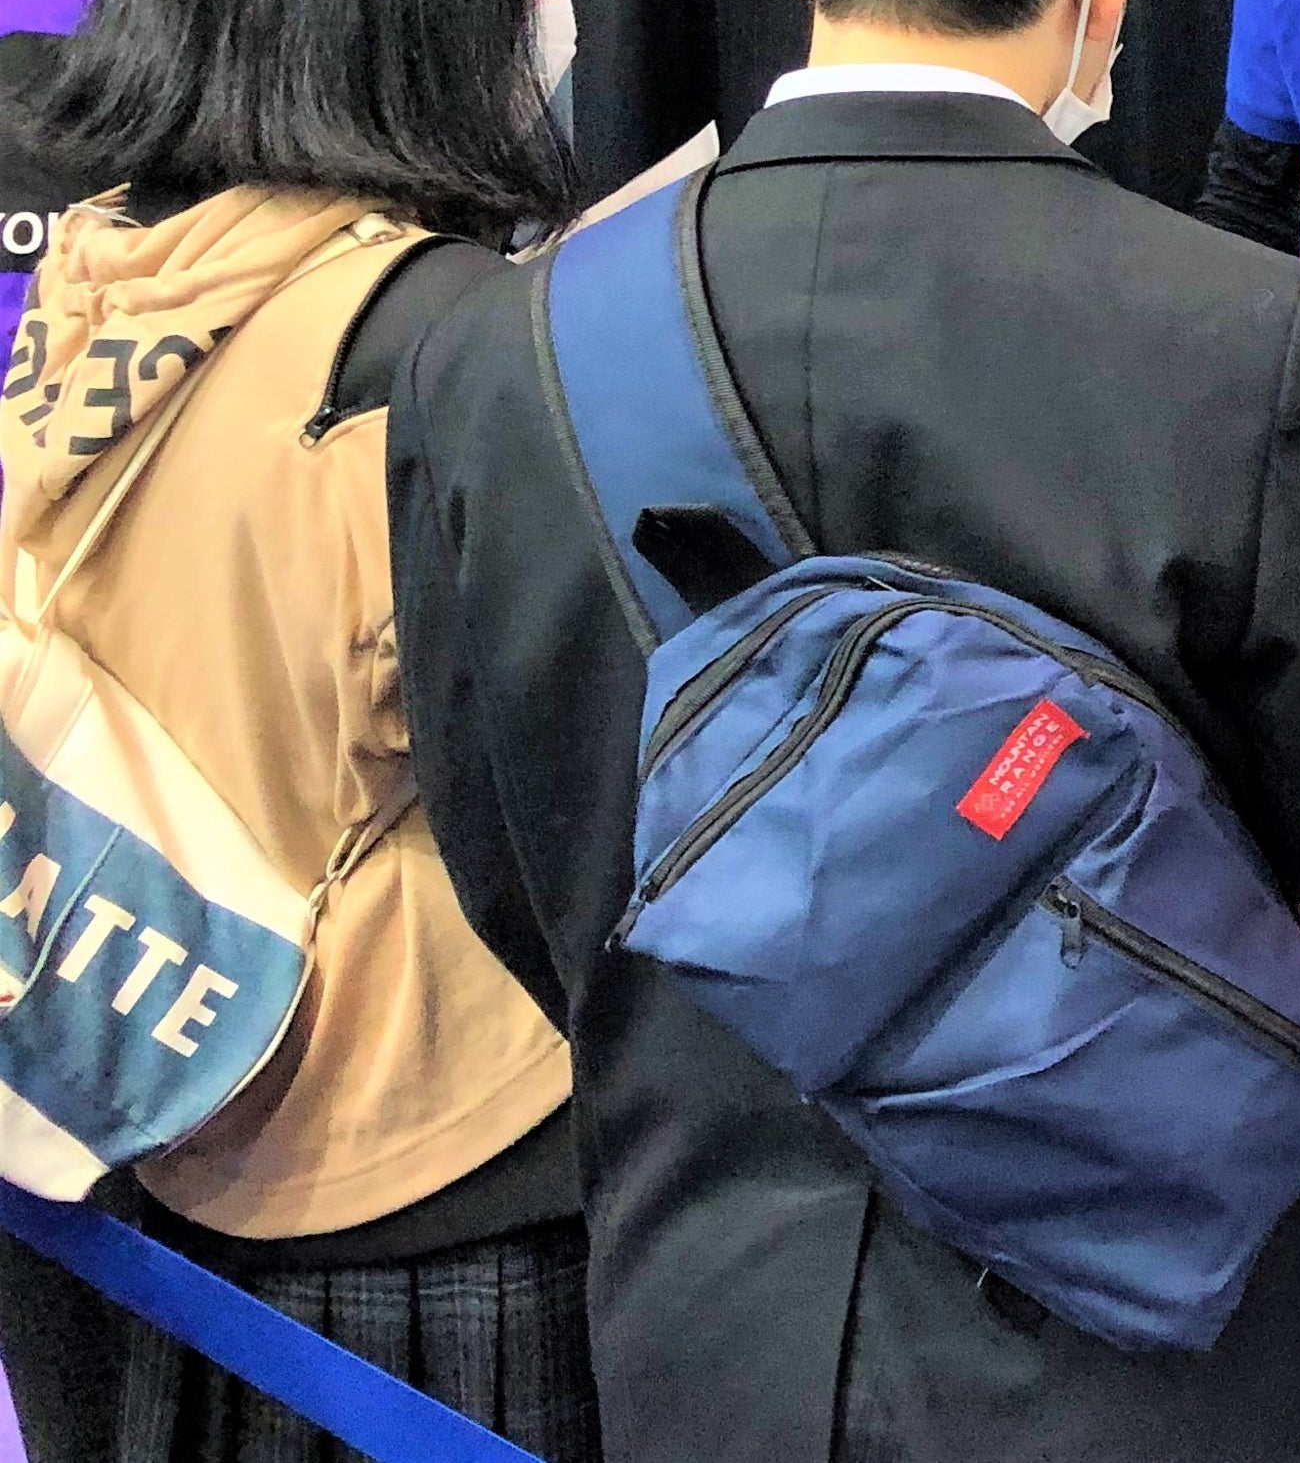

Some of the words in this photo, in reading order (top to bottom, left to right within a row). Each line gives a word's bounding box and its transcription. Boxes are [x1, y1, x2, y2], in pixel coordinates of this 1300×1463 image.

[988, 713, 1050, 786] MOUNTAIN
[1000, 722, 1061, 794] RANGE
[0, 800, 240, 1059] ATTE
